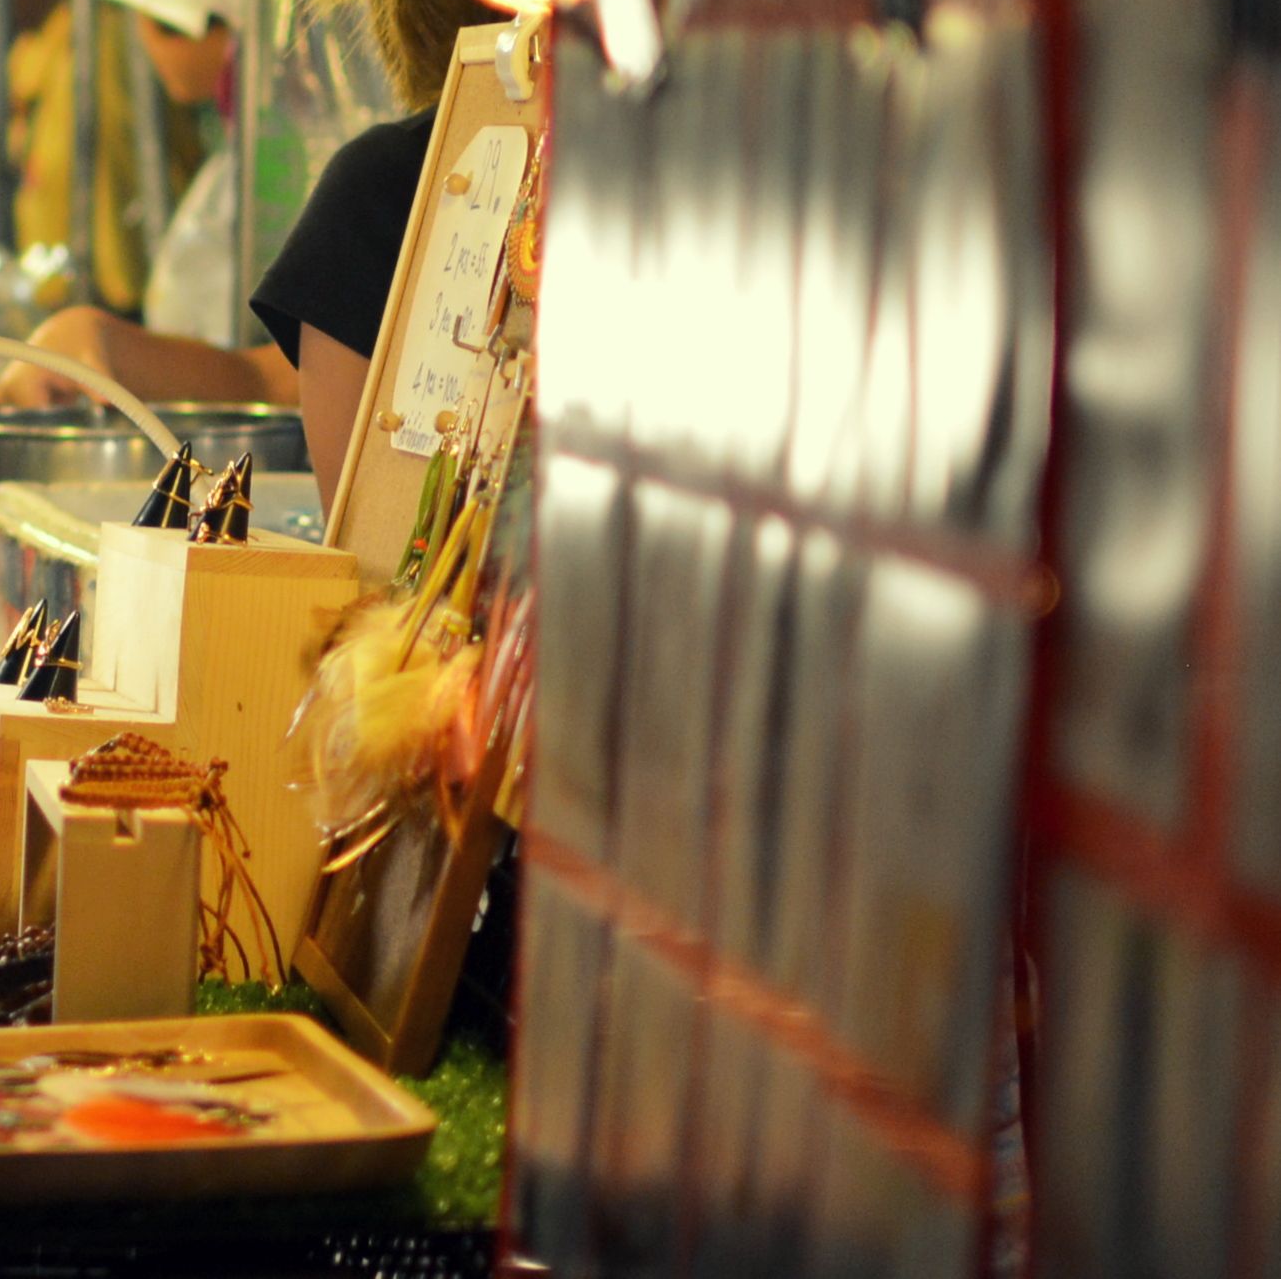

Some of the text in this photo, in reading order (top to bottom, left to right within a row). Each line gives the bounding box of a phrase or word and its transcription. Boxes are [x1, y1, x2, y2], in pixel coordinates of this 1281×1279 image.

[443, 232, 458, 272] 2
[429, 291, 443, 331] 3
[413, 361, 424, 395] 4
